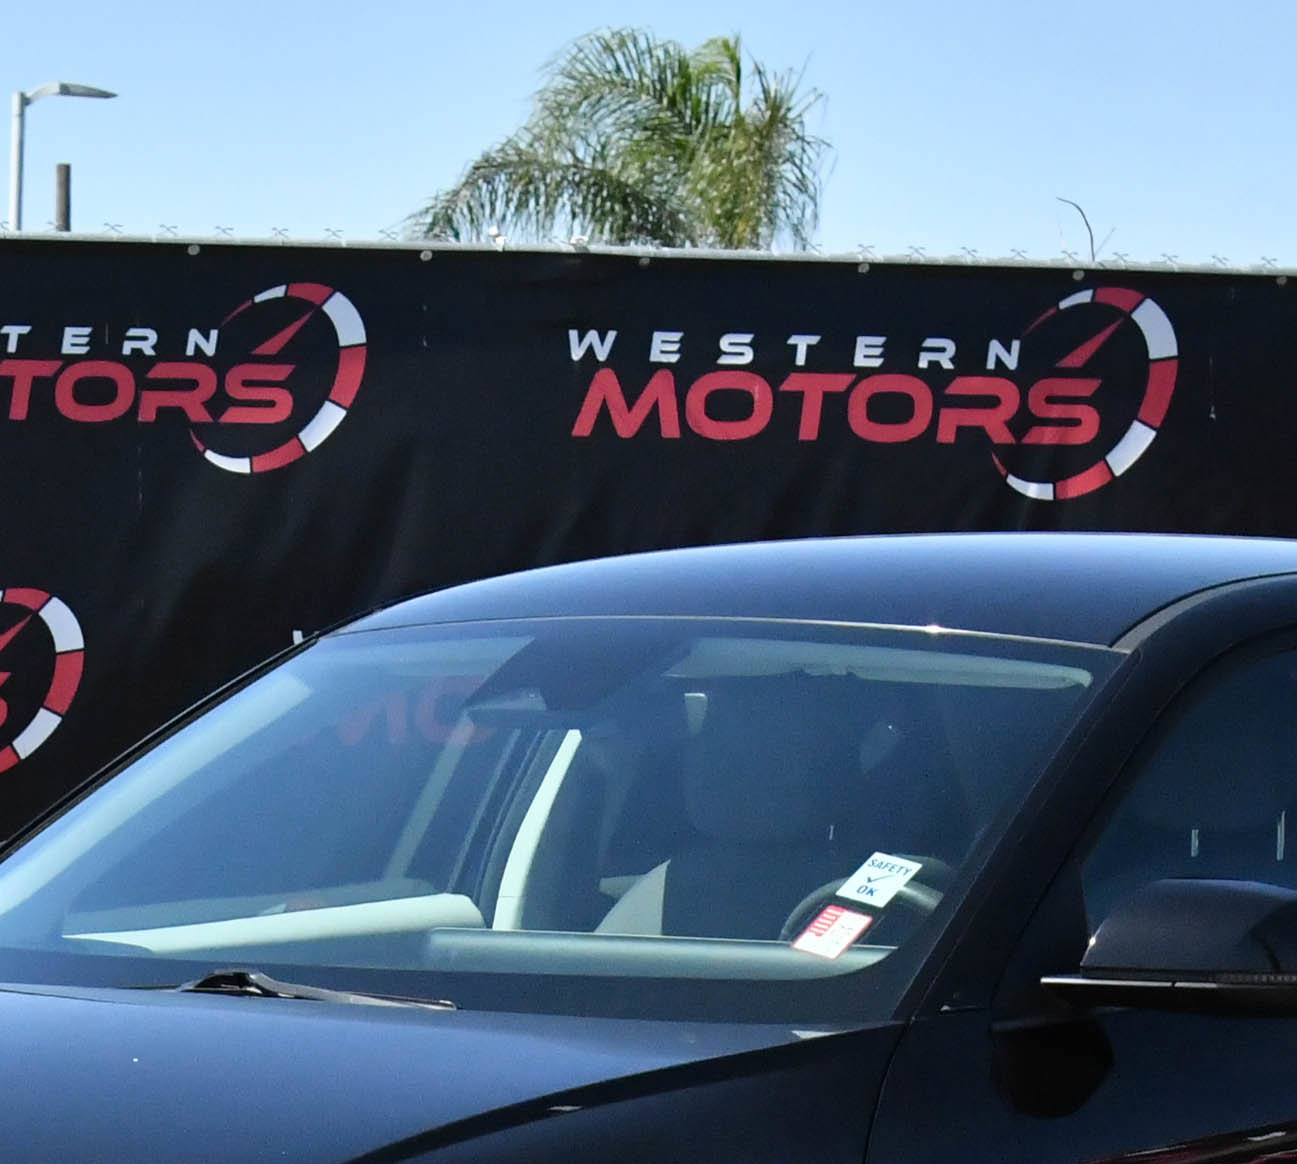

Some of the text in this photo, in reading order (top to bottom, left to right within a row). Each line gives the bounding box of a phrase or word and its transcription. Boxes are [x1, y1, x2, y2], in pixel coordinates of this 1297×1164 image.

[568, 329, 1021, 370] WESTERN
[570, 367, 1102, 445] MOTORS
[867, 858, 912, 877] SAFETY
[856, 885, 879, 898] OK
